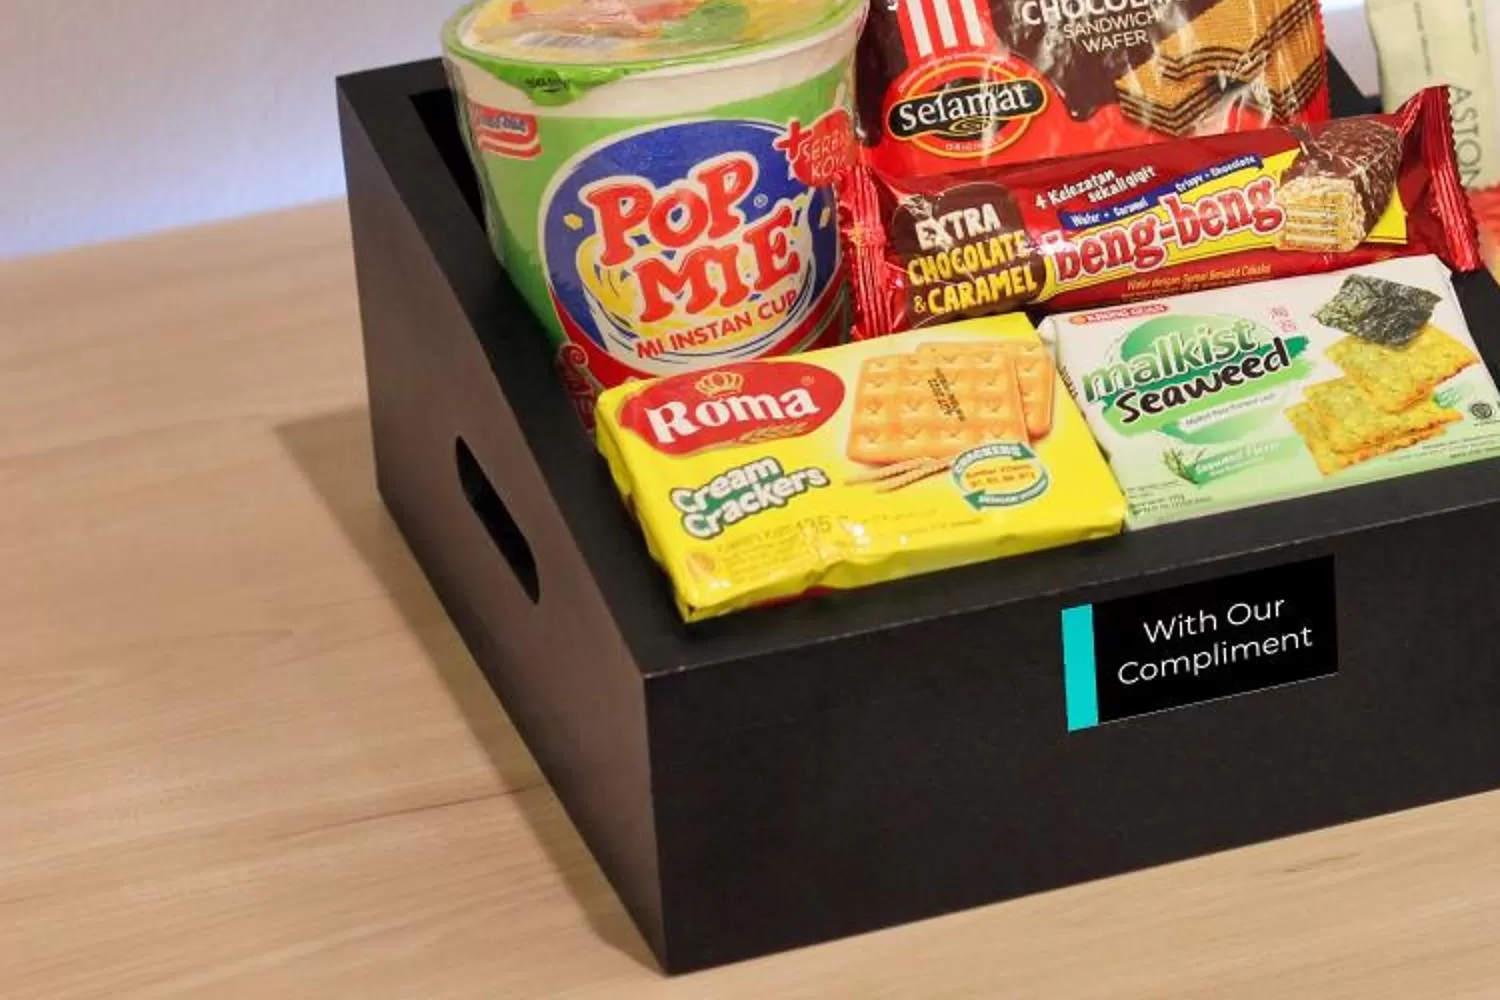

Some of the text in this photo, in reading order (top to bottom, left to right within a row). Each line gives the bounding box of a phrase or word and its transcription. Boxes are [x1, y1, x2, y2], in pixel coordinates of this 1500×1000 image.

[1063, 10, 1158, 40] SANDWICH
[1081, 30, 1149, 54] WAFER
[585, 159, 753, 267] POP
[1035, 169, 1116, 210] 4 Kelezatan
[1069, 155, 1257, 229] Wafer Caramel Crispy Chocolate
[915, 203, 1001, 252] EXTRA
[1045, 178, 1285, 284] beng-beng
[635, 206, 800, 323] MIE
[907, 229, 1031, 287] CHOCOLATE
[913, 264, 1038, 315] & CARAMEL
[636, 289, 798, 359] MI INSTAN CUP
[1081, 318, 1258, 402] malkist
[1115, 336, 1290, 424] Seaweed
[644, 387, 821, 444] Roma
[671, 457, 784, 513] Cream
[682, 467, 830, 540] Crackers
[1143, 599, 1285, 643] With Our
[1117, 626, 1313, 685] Compliment
